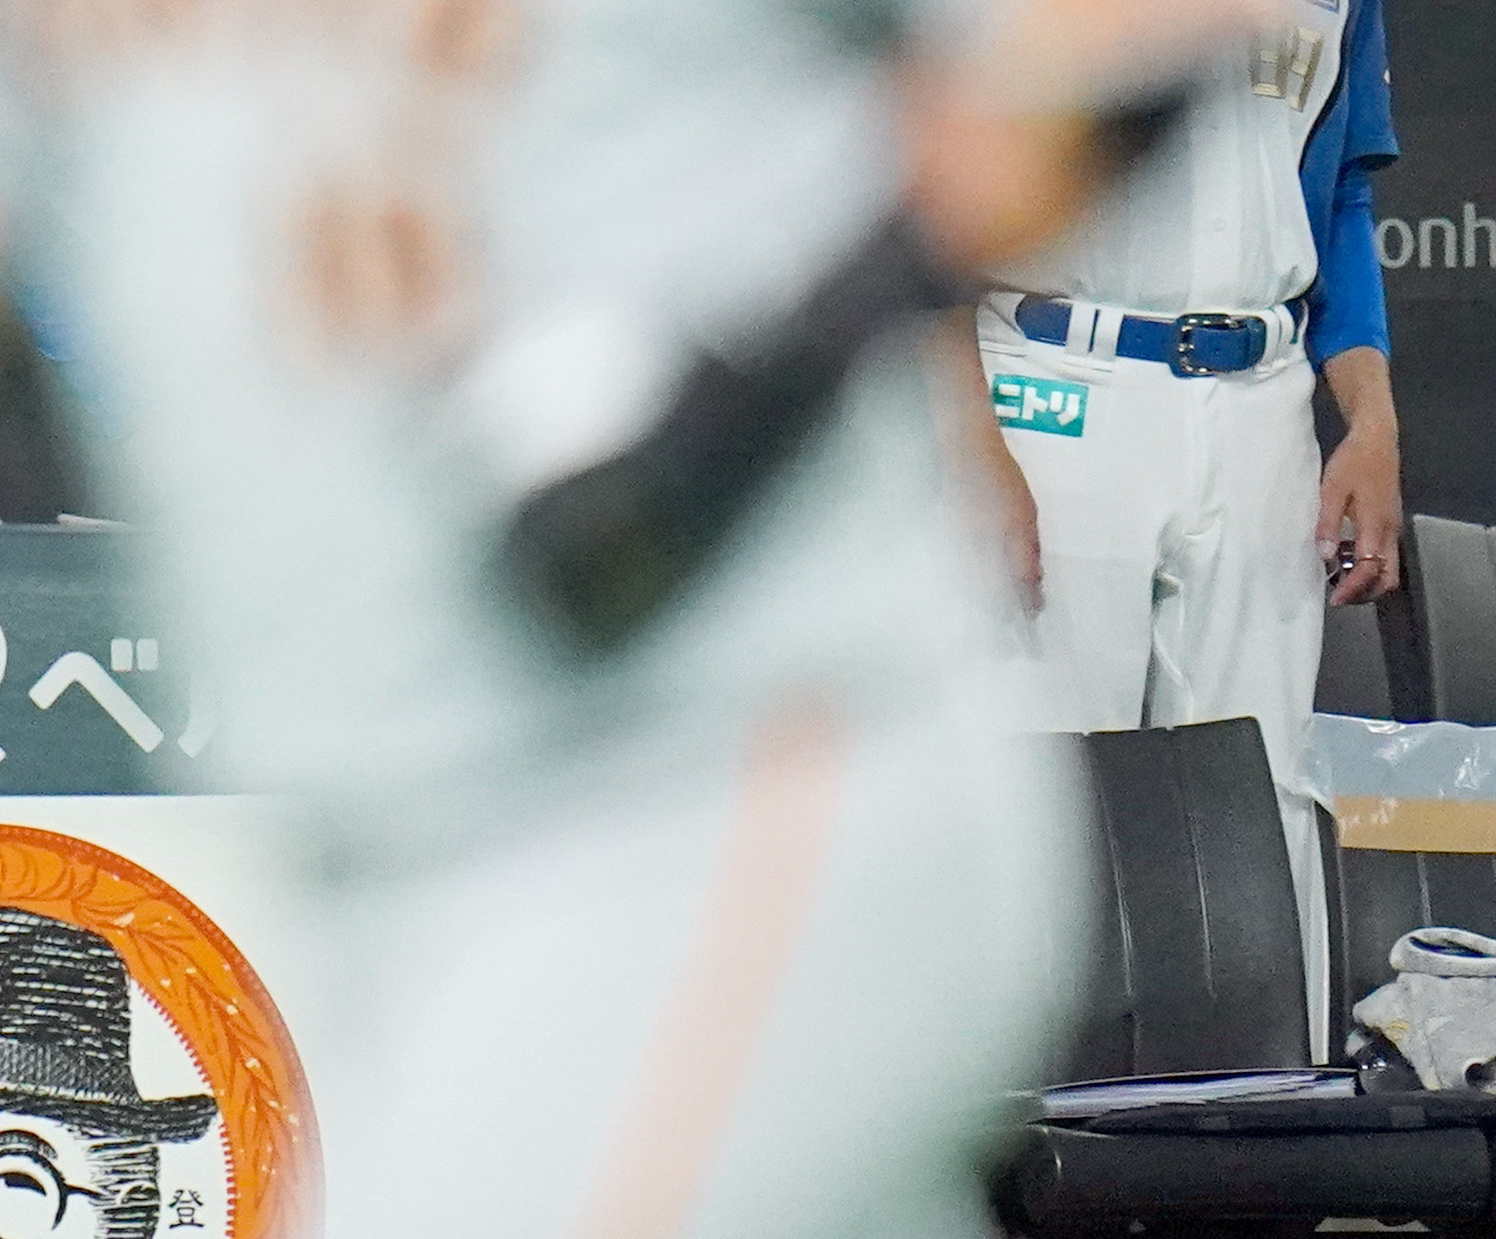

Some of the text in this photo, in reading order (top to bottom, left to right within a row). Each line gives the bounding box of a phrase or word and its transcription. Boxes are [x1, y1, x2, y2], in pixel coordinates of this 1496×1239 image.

[994, 383, 1081, 427] ニトリ
[168, 1188, 205, 1229] 登
